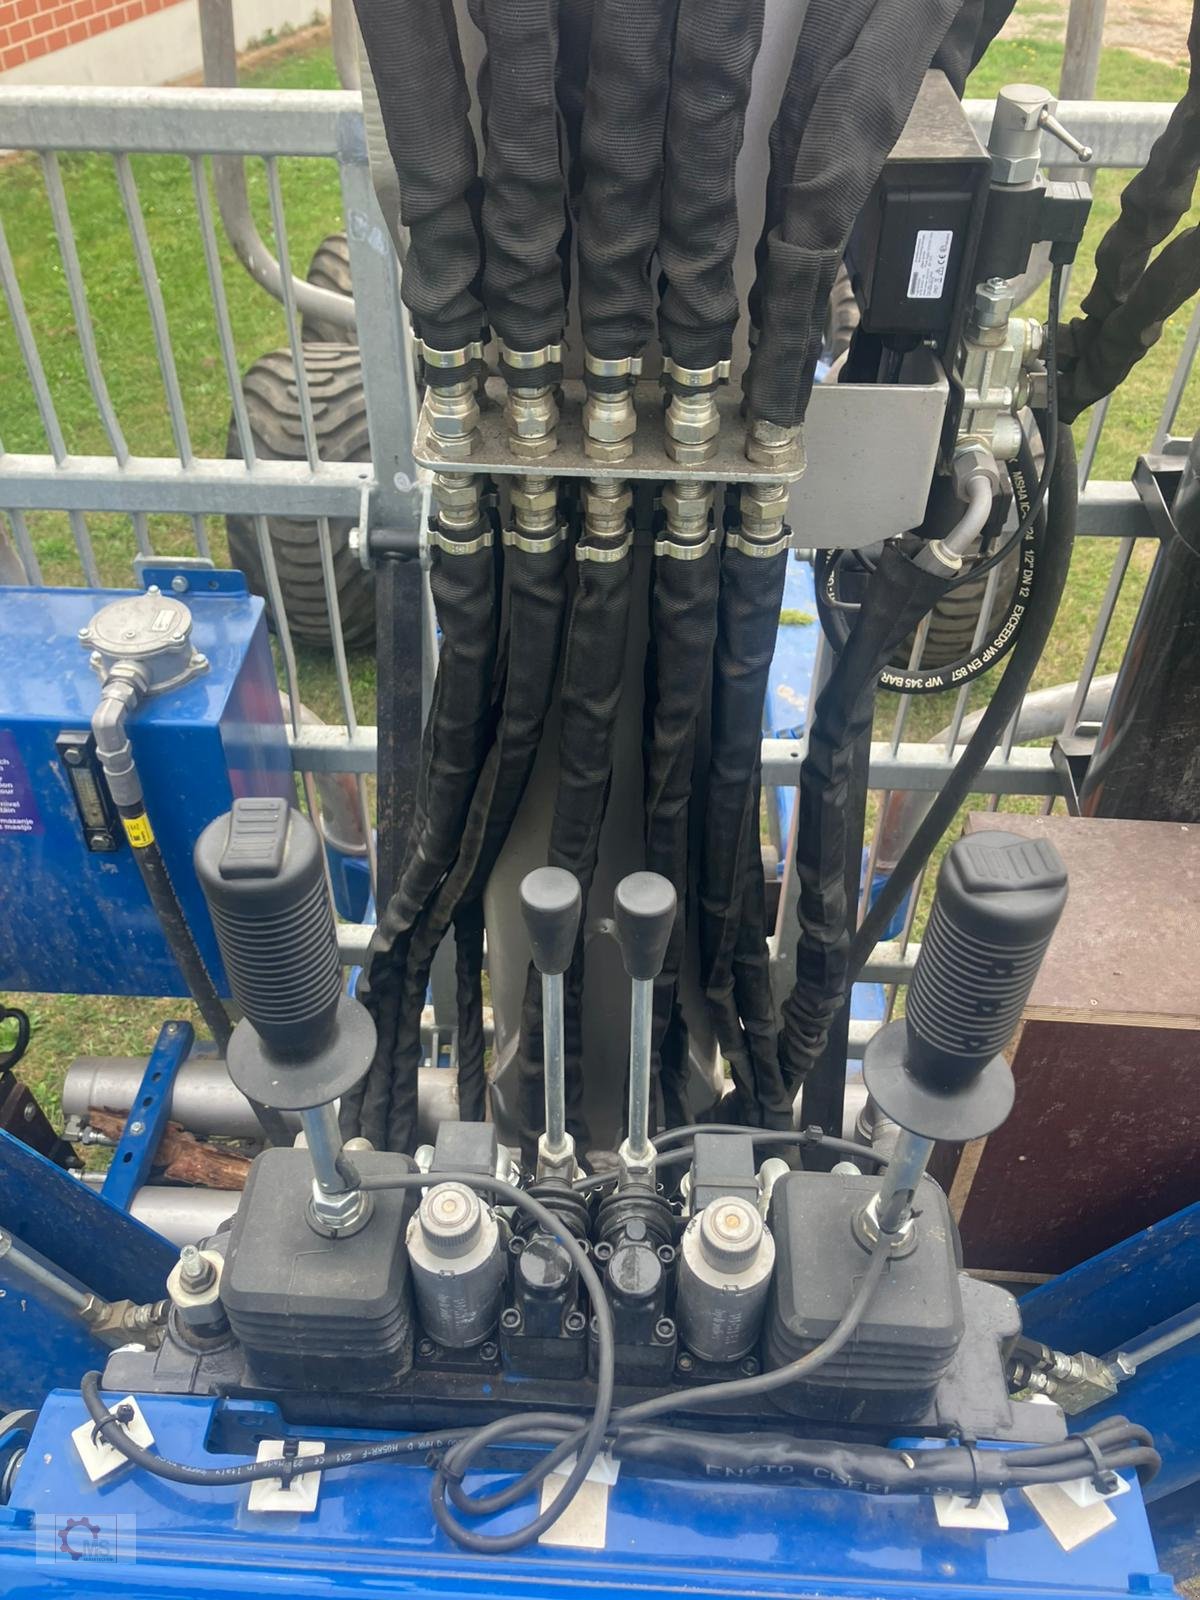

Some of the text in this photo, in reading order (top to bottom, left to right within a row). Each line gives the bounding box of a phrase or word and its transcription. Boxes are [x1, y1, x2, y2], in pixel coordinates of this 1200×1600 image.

[1012, 471, 1027, 502] MSHA
[1021, 569, 1033, 586] DN
[1018, 585, 1030, 598] 12
[995, 604, 1024, 648] EXCEEDS
[981, 642, 1002, 663] WP
[951, 666, 969, 682] 857
[967, 658, 984, 674] EN
[880, 672, 905, 688] BAR
[904, 676, 924, 689] 345
[925, 675, 944, 689] WP
